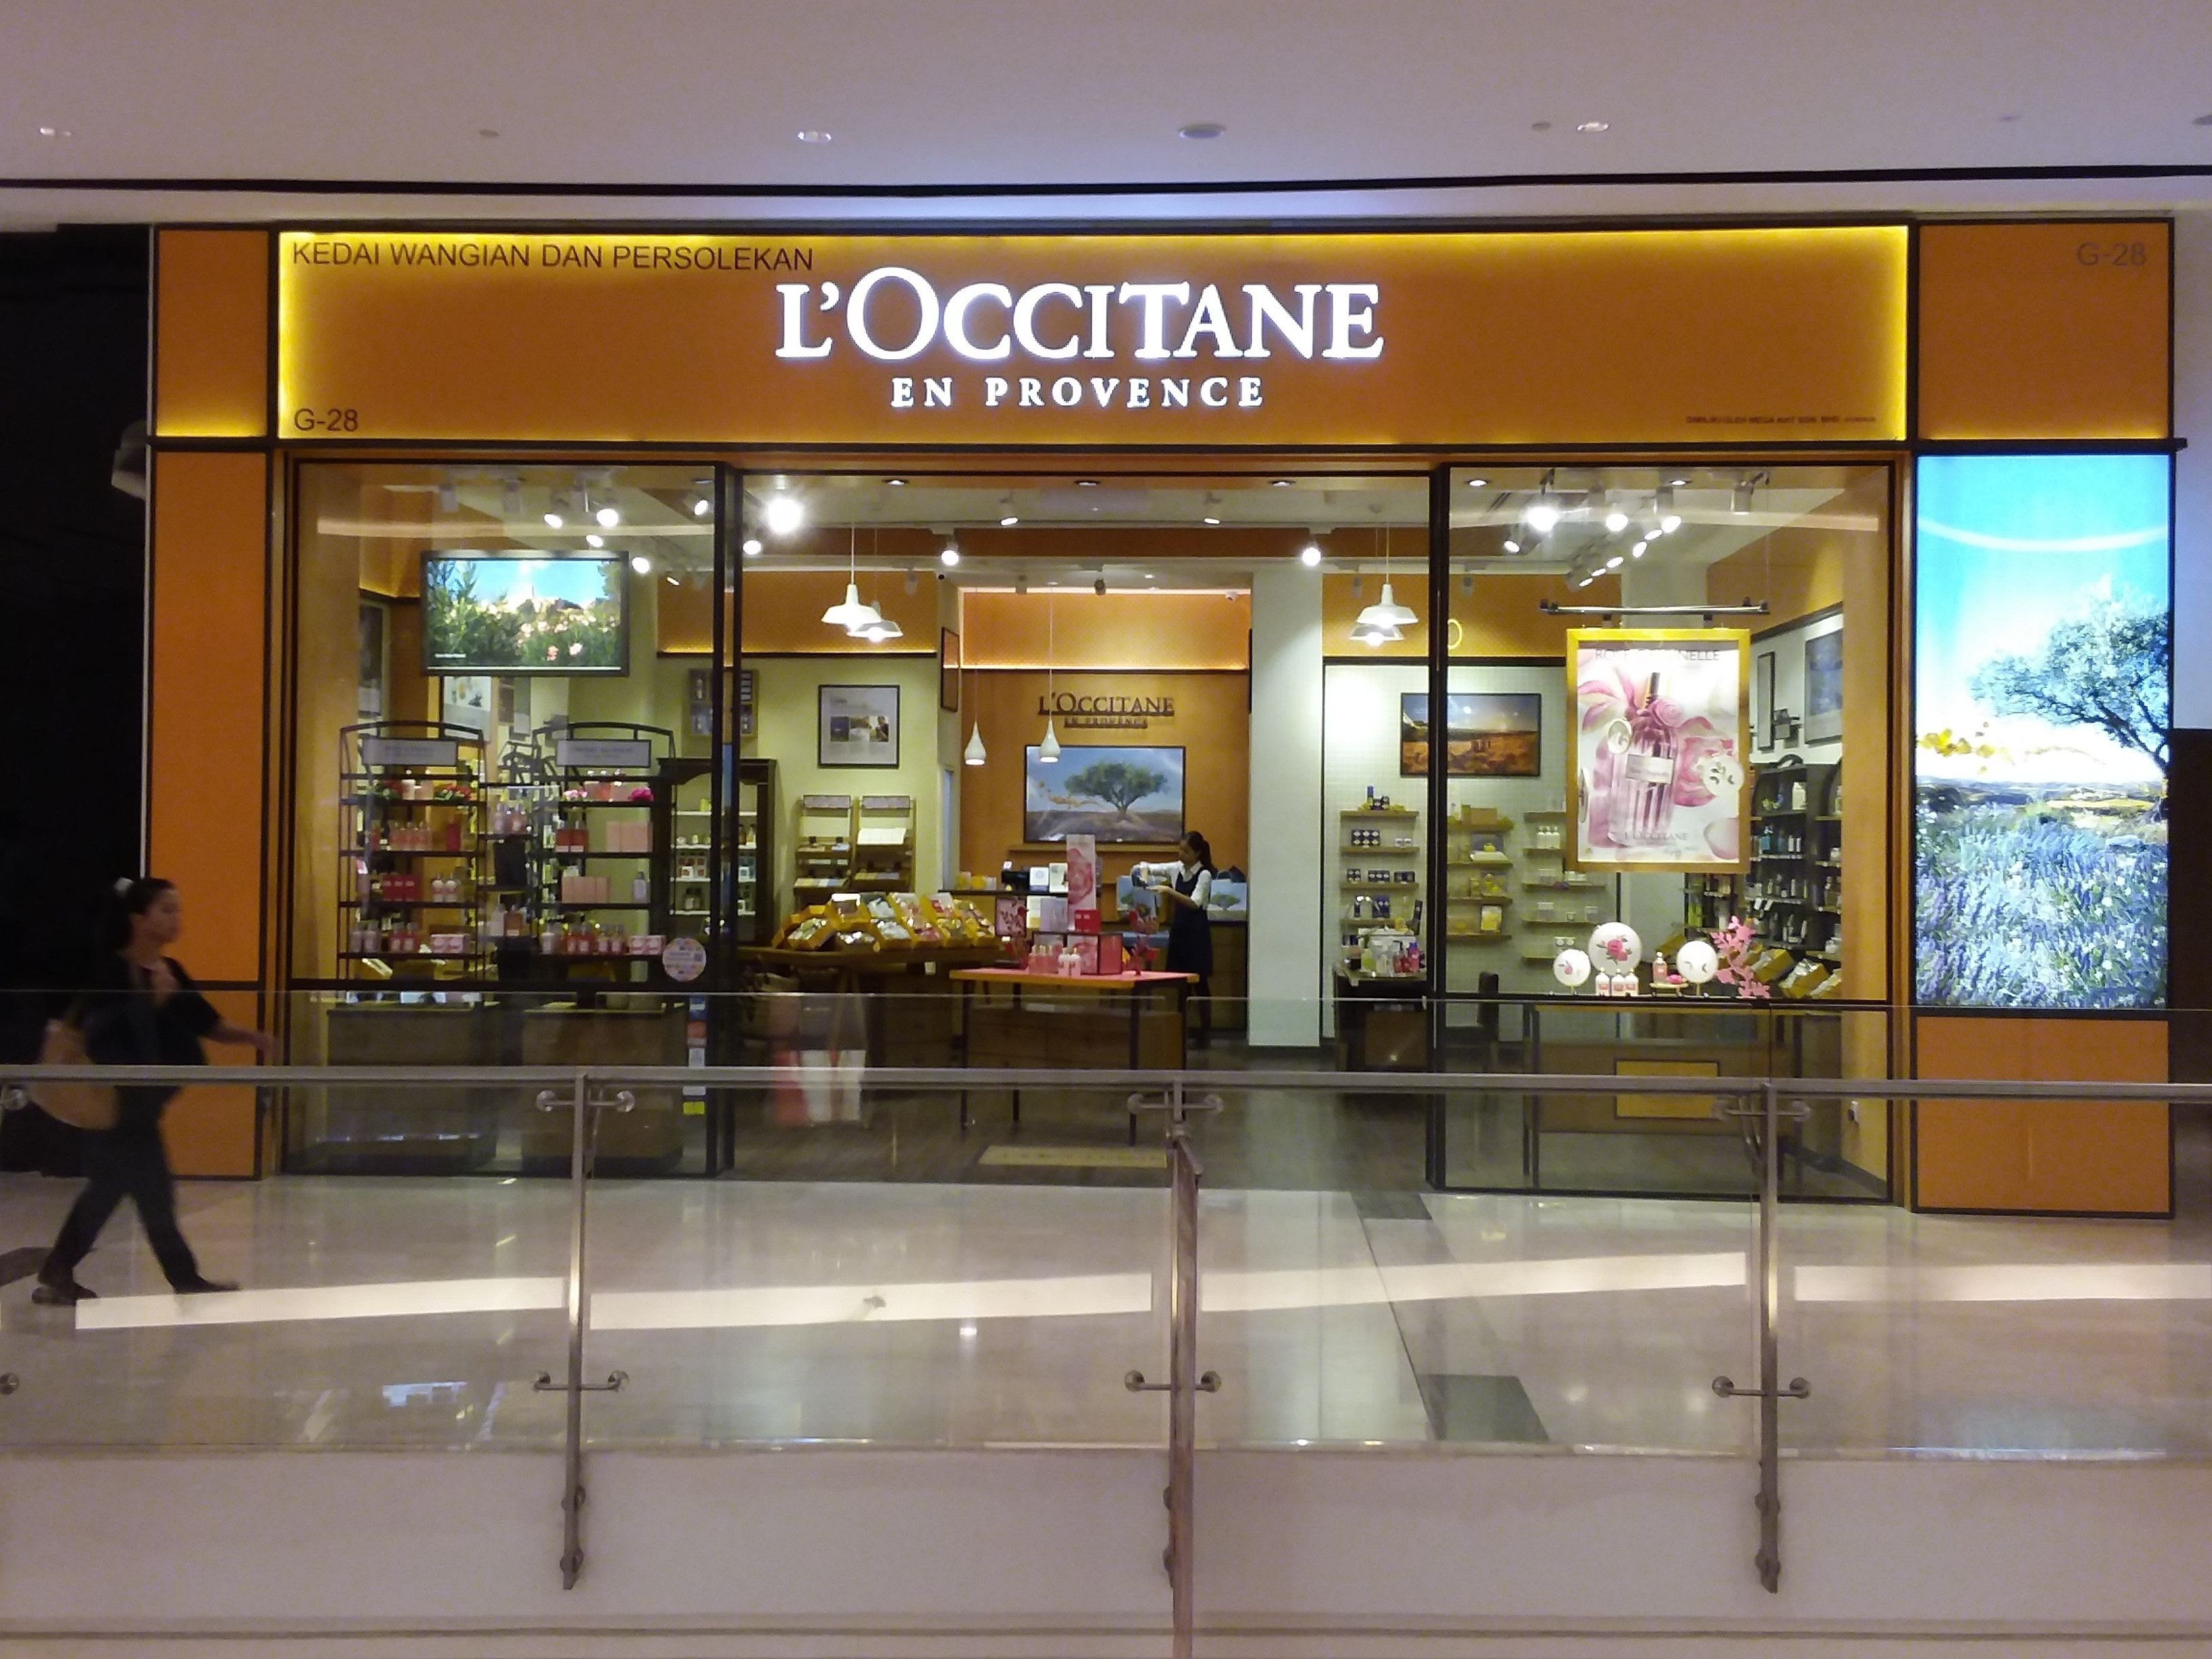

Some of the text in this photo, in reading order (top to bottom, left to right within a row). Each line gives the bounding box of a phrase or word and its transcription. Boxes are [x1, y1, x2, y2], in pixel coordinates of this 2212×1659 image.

[293, 242, 813, 271] KEDAI WANGIAN DAN PERSOLEKAN
[2076, 242, 2147, 266] G-28
[775, 267, 1384, 361] L'OCCITANE
[890, 377, 1264, 408] EN PROVENCE
[294, 408, 359, 432] G-28
